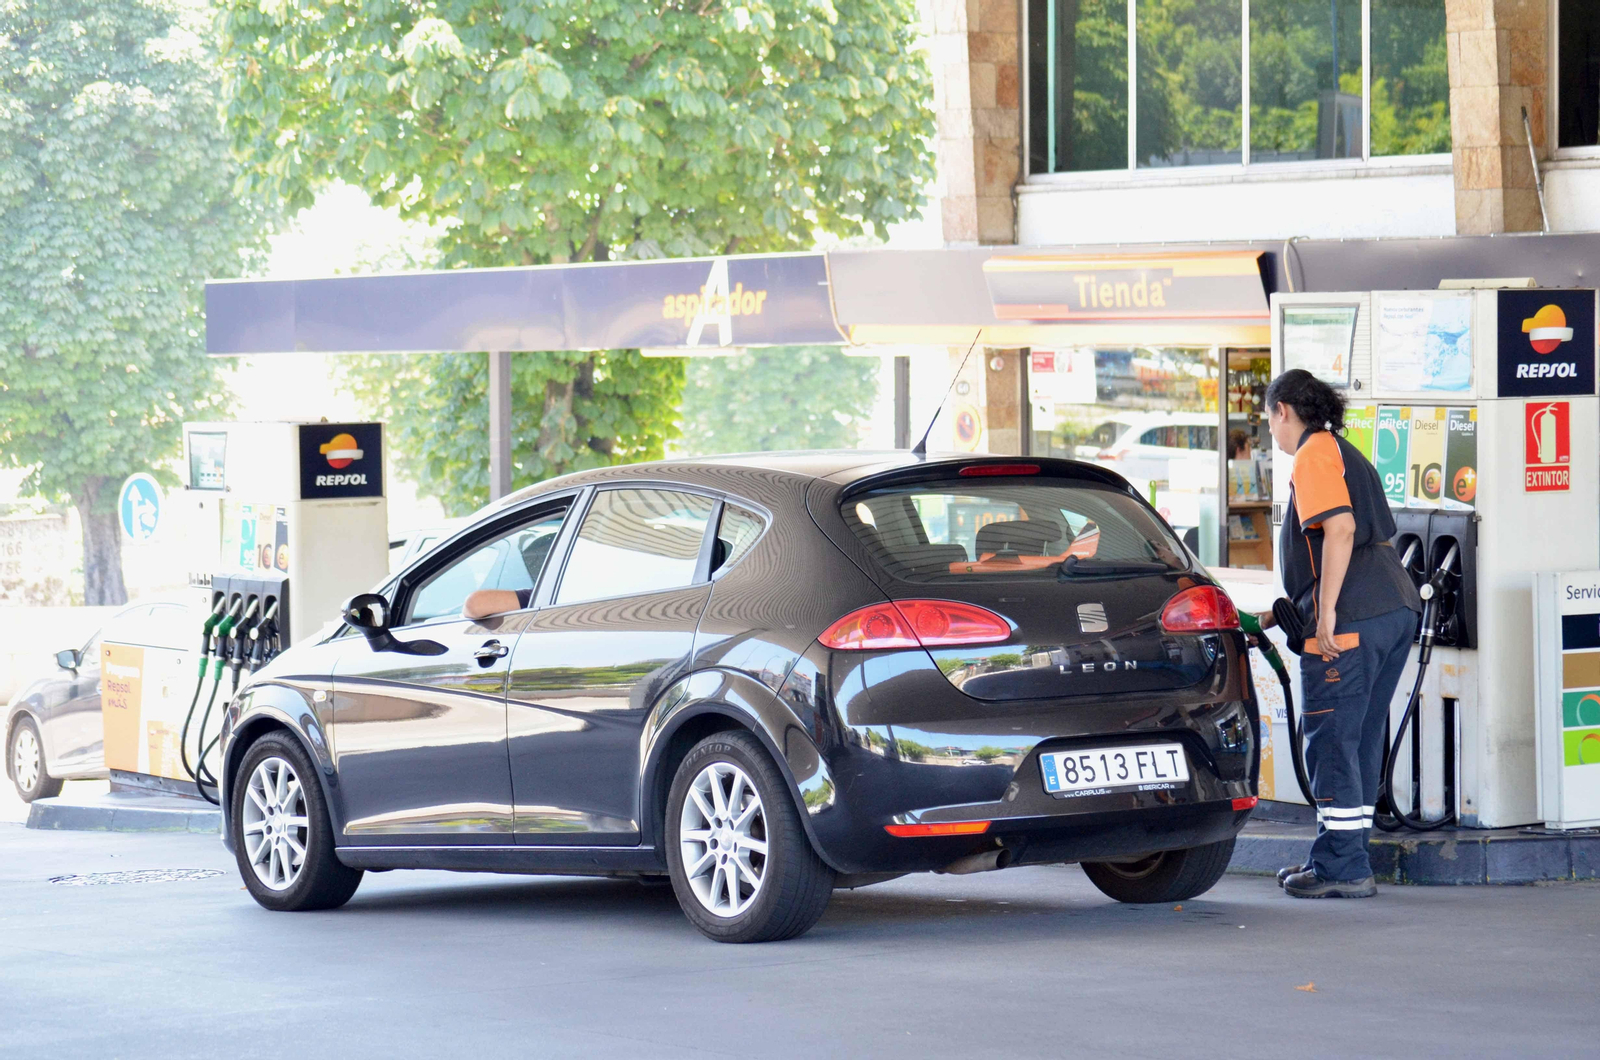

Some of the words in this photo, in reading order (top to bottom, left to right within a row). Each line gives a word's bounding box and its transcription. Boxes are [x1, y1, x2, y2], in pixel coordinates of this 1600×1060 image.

[1073, 271, 1167, 308] Tienda
[662, 281, 767, 327] aspirador
[1331, 353, 1344, 377] 4
[1516, 362, 1578, 378] REPSOL
[1345, 417, 1373, 429] efitec
[1379, 417, 1409, 430] efitec
[1414, 419, 1439, 430] Diesel
[1450, 419, 1475, 431] Diesel
[315, 473, 368, 486] REPSOL
[1384, 472, 1405, 493] 95
[1526, 470, 1569, 487] EXTINTOR
[1059, 660, 1137, 675] LEON
[1275, 708, 1288, 719] VIS
[685, 743, 732, 768] DUNLOP
[1063, 753, 1129, 784] 8513
[1135, 750, 1179, 779] FLT
[1049, 776, 1056, 785] E
